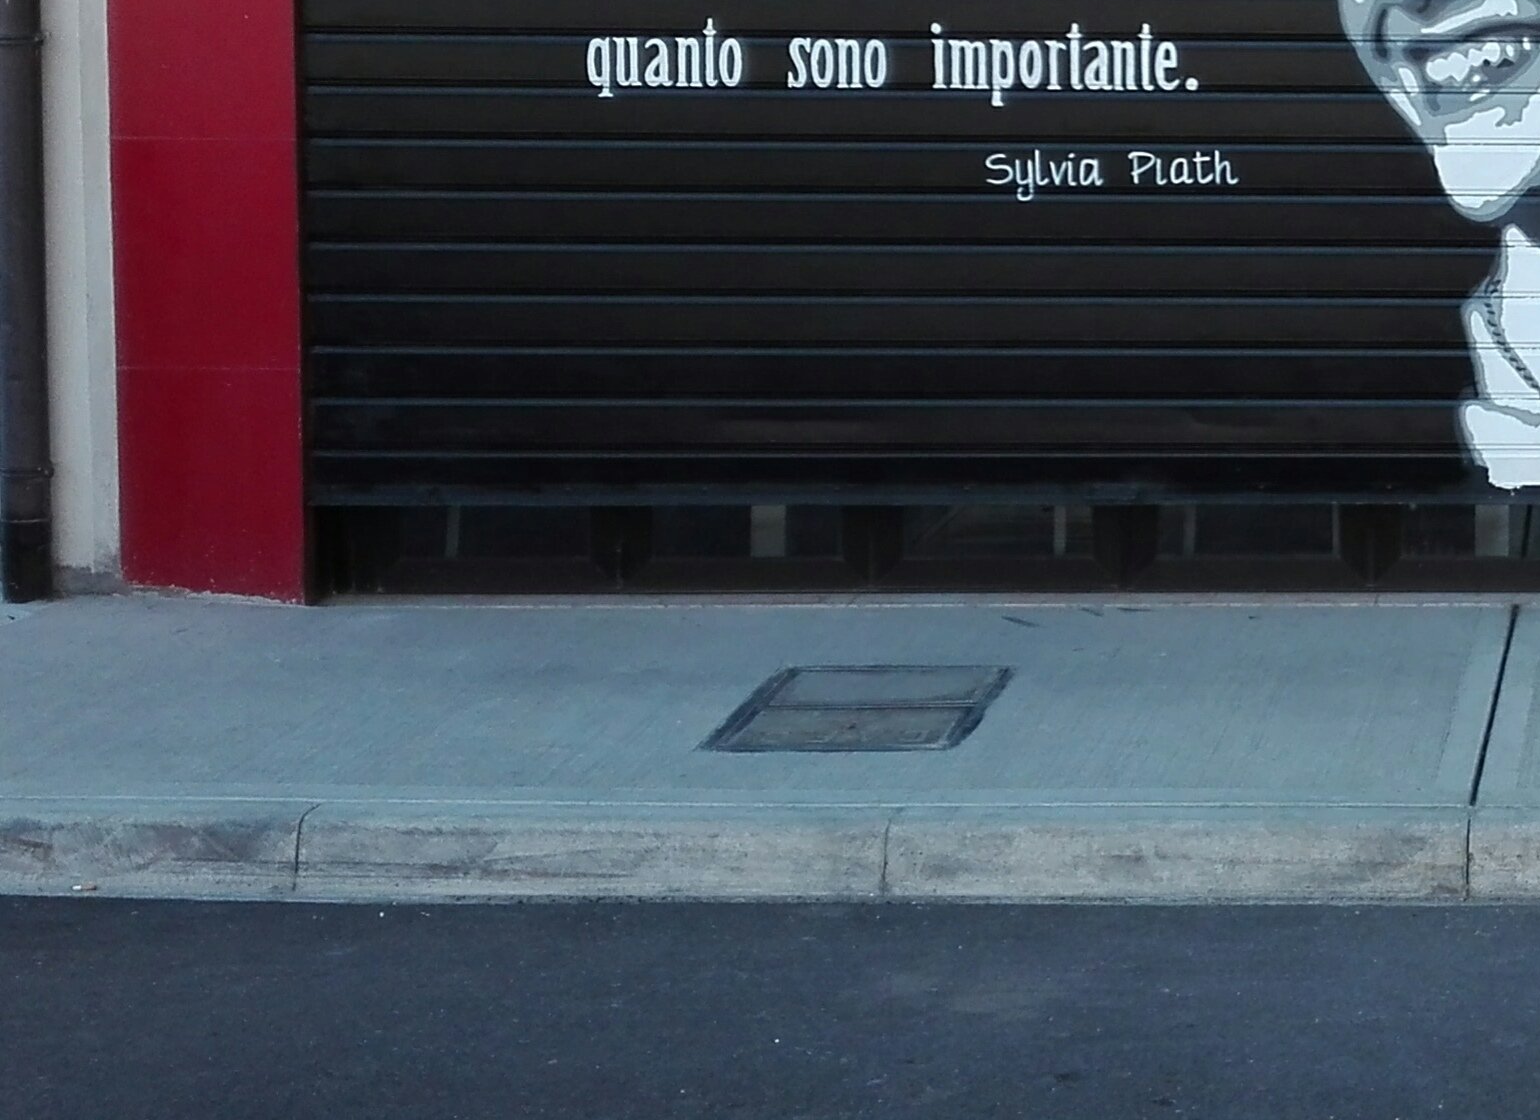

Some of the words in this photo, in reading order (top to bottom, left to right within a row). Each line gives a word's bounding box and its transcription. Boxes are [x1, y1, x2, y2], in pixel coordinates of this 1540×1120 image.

[585, 16, 744, 98] quanto
[786, 36, 888, 90] sono
[929, 21, 1200, 108] importante.
[984, 148, 1105, 203] Sylvia
[1126, 148, 1240, 186] Plath
